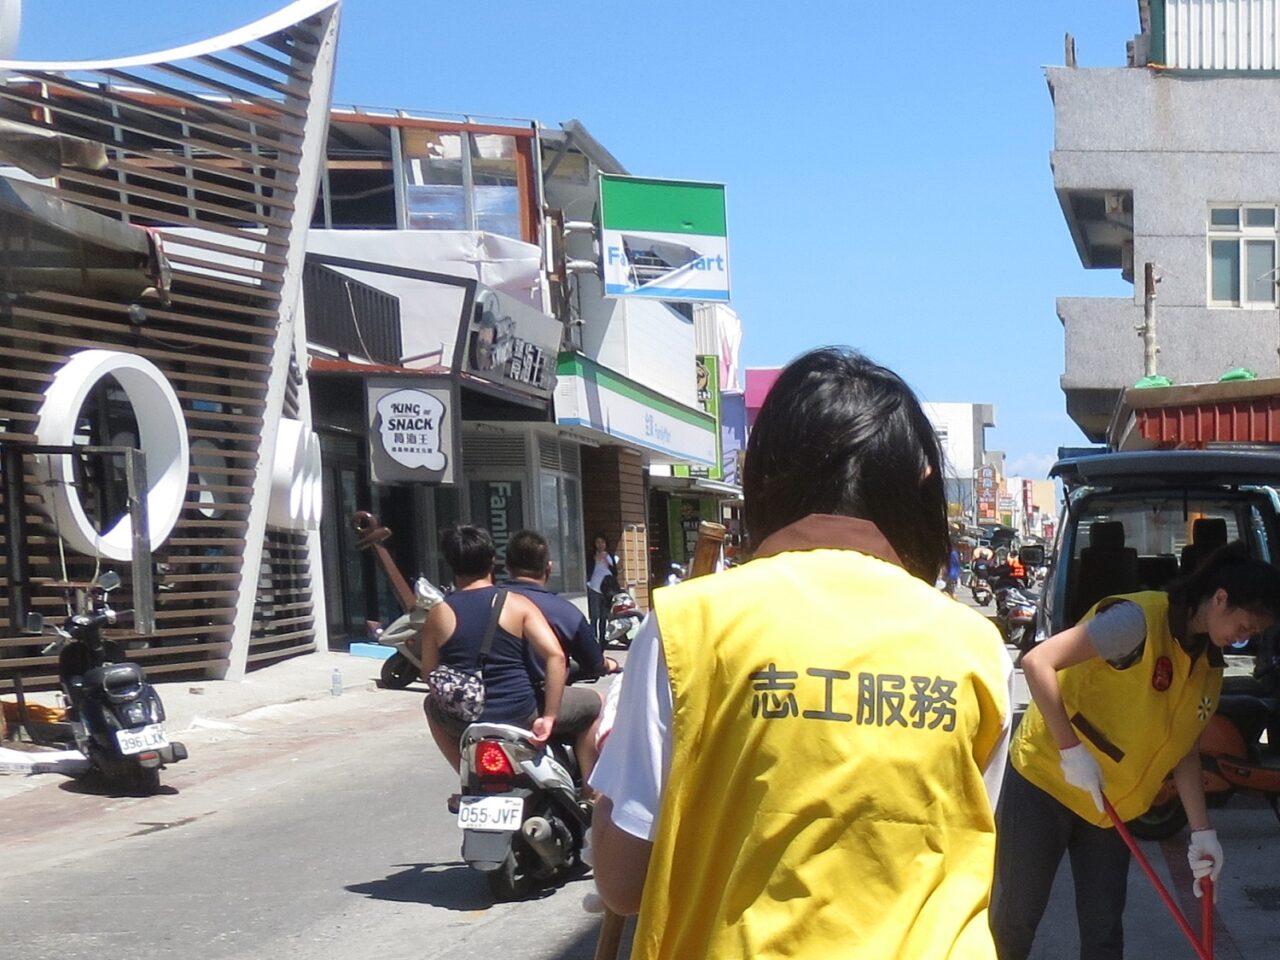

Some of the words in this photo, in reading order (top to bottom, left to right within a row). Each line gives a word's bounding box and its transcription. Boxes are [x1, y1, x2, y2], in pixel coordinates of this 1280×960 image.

[391, 403, 420, 417] KING
[388, 419, 433, 431] SNACK
[749, 662, 958, 733] 志工服務
